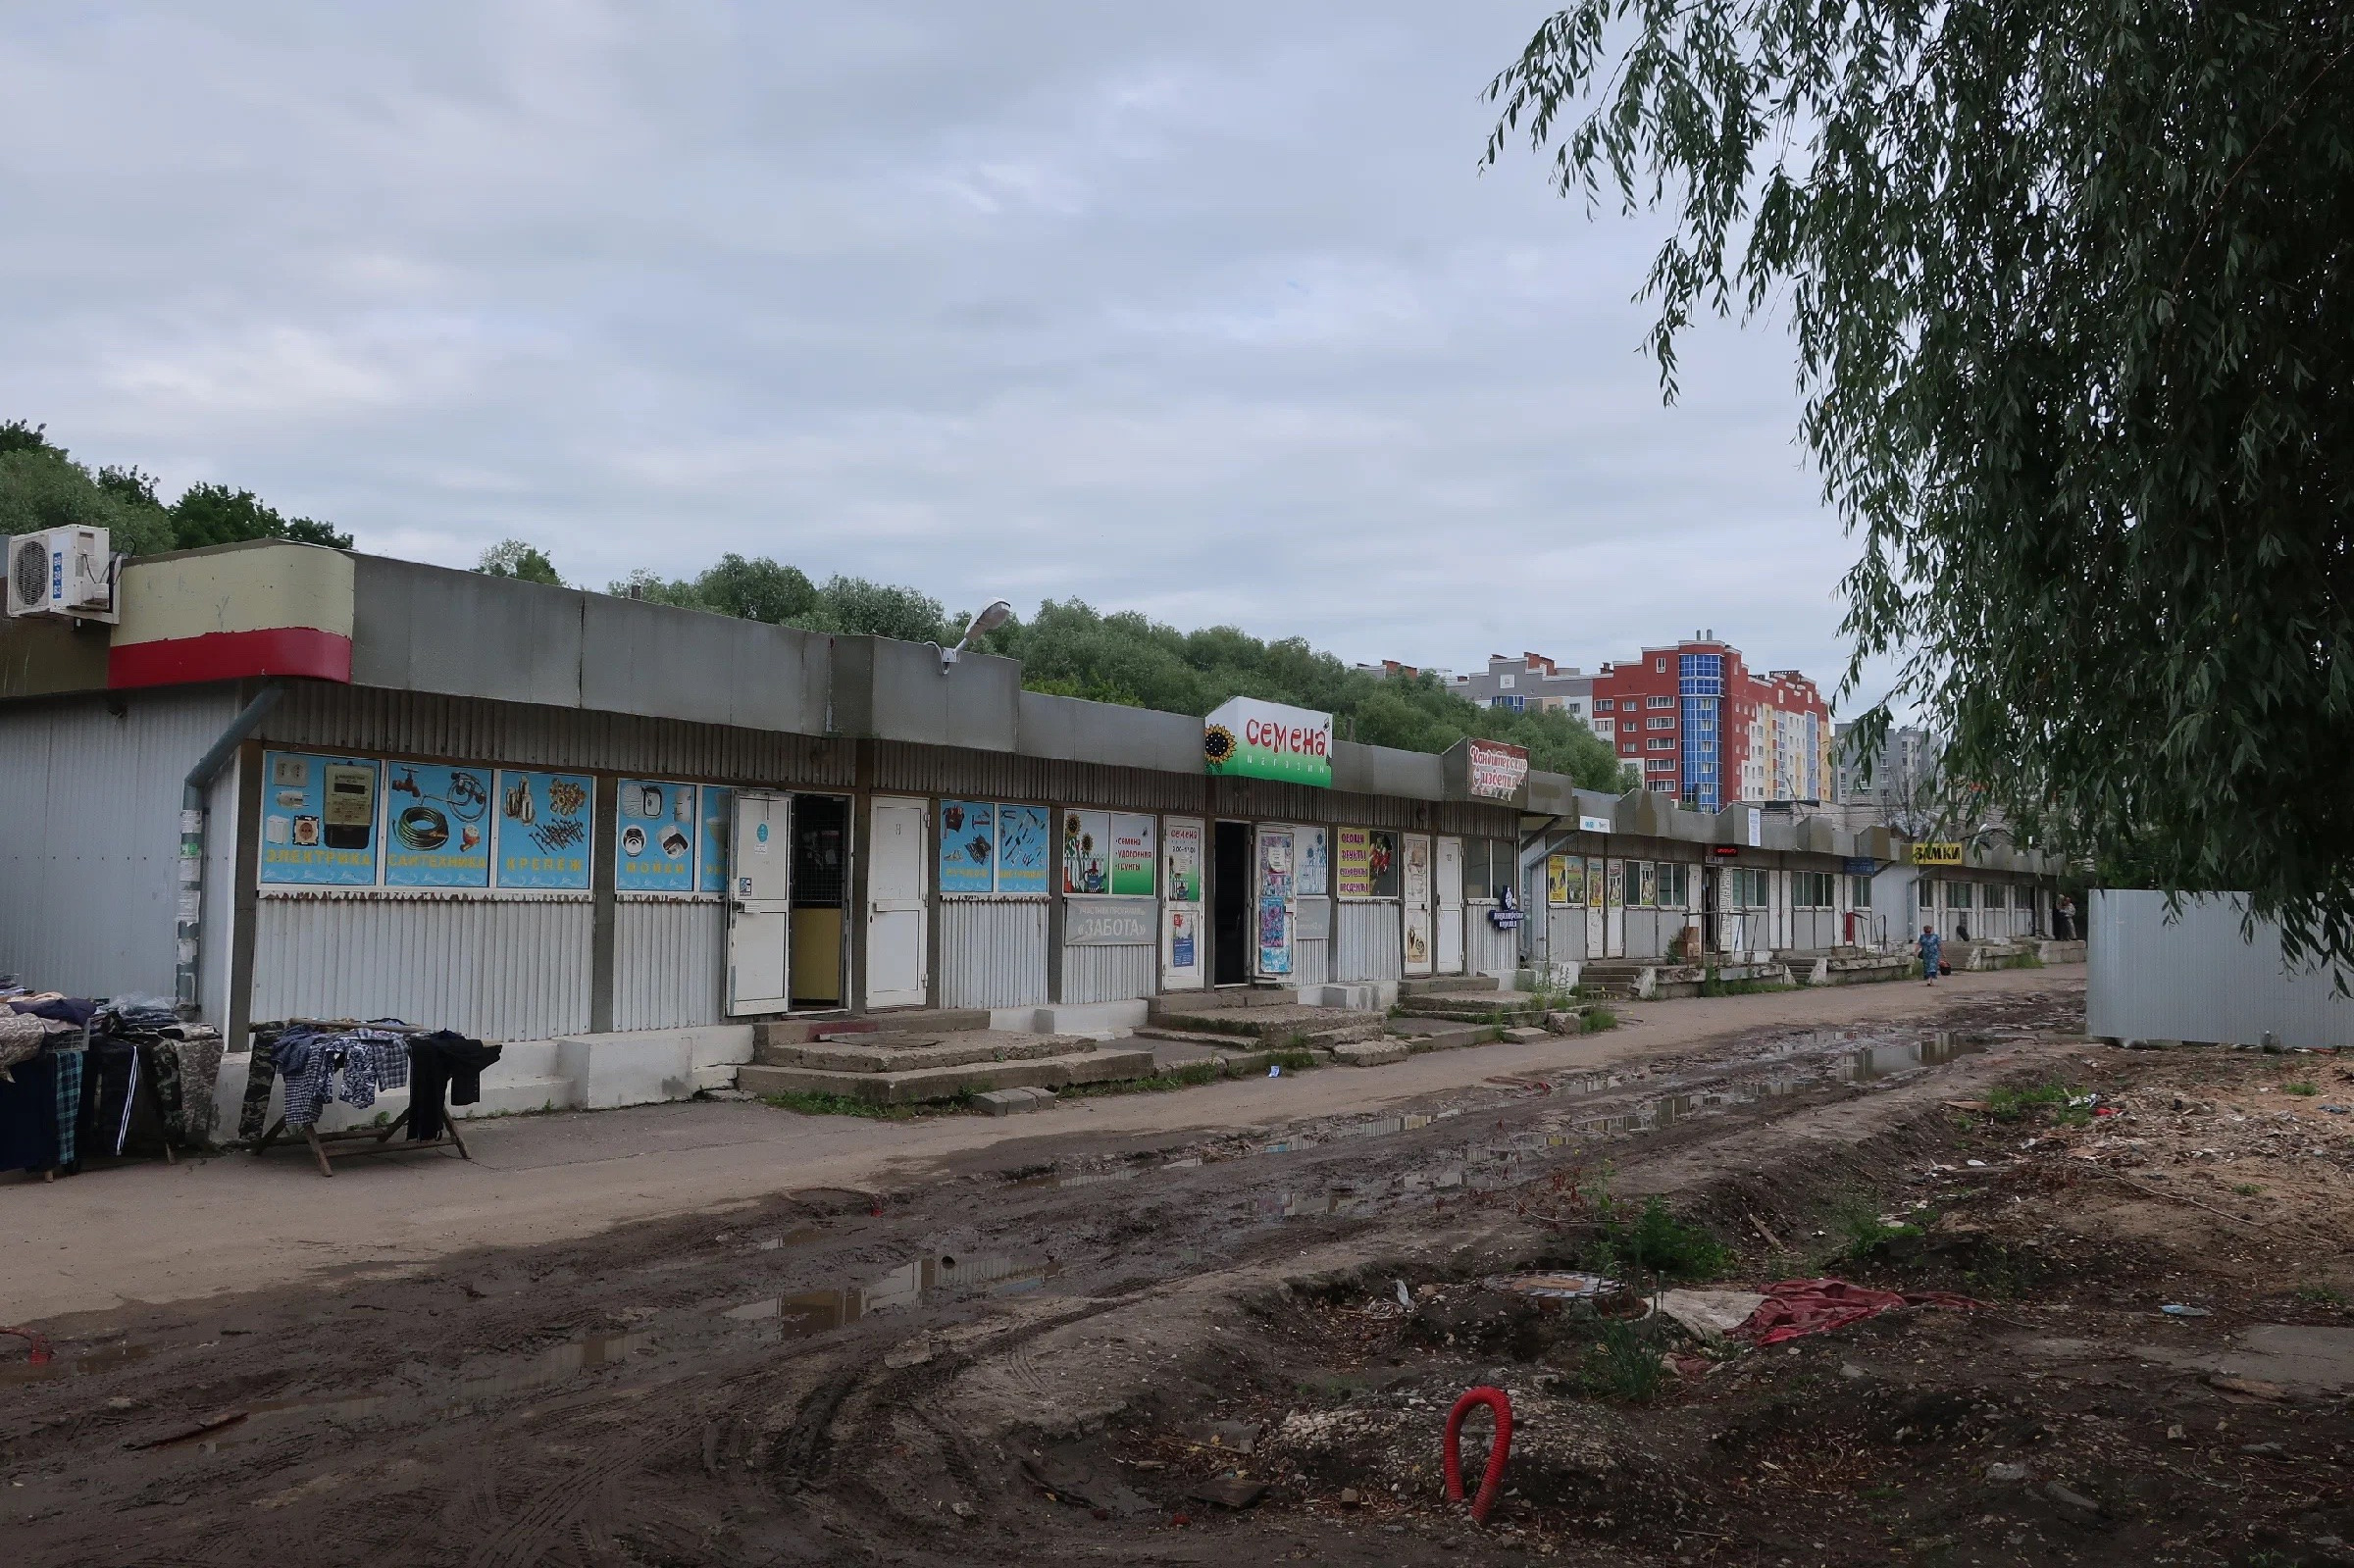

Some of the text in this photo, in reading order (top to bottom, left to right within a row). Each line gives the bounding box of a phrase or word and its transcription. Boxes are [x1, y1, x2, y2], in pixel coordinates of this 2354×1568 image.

[266, 849, 372, 866] ЭЛЕКТРИКА
[1915, 847, 1960, 859] ЗАМКИ
[387, 854, 486, 869] САНТЕХНИКА
